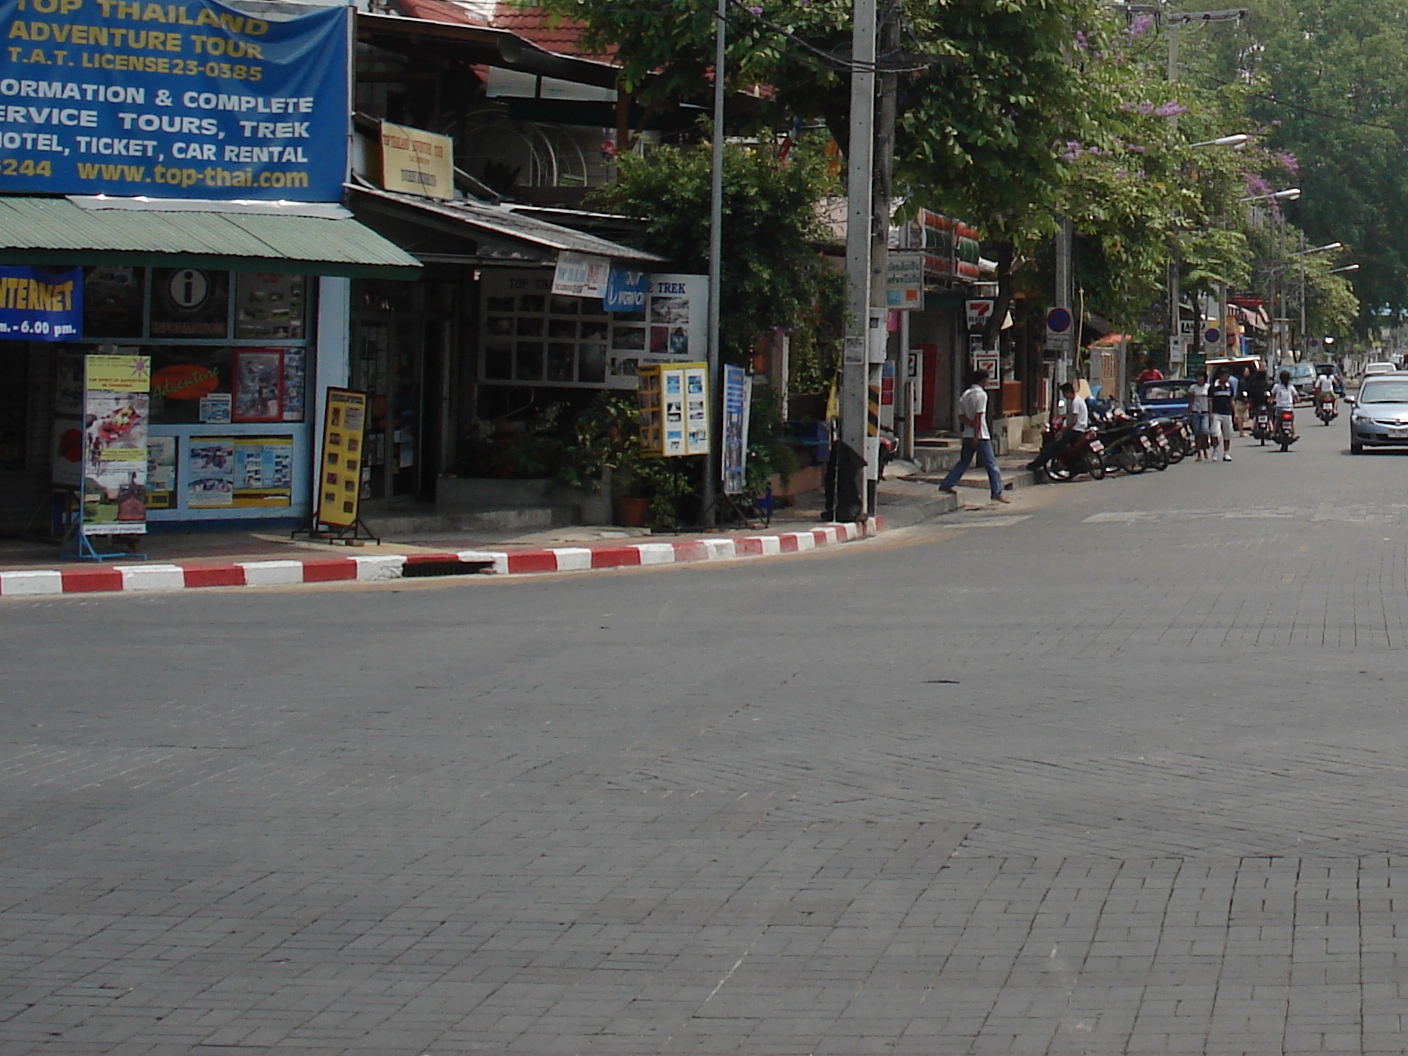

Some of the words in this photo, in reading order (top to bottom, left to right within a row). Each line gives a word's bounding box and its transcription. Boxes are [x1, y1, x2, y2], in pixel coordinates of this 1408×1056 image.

[9, 19, 182, 52] ADVENTURE
[191, 33, 264, 60] TOUR
[10, 46, 74, 67] T.A.T.
[154, 89, 173, 107] &
[183, 91, 314, 113] COMPLETE
[119, 112, 226, 140] TOURS,
[240, 121, 310, 139] TREK
[0, 131, 70, 157] OTEL,
[76, 136, 165, 162] TICKET,
[172, 141, 216, 161] CAR
[224, 145, 308, 163] RENTAL
[0, 159, 52, 178] 244
[77, 162, 309, 188] www.top-thai.com
[658, 282, 687, 294] TREK
[53, 324, 77, 338] pm.
